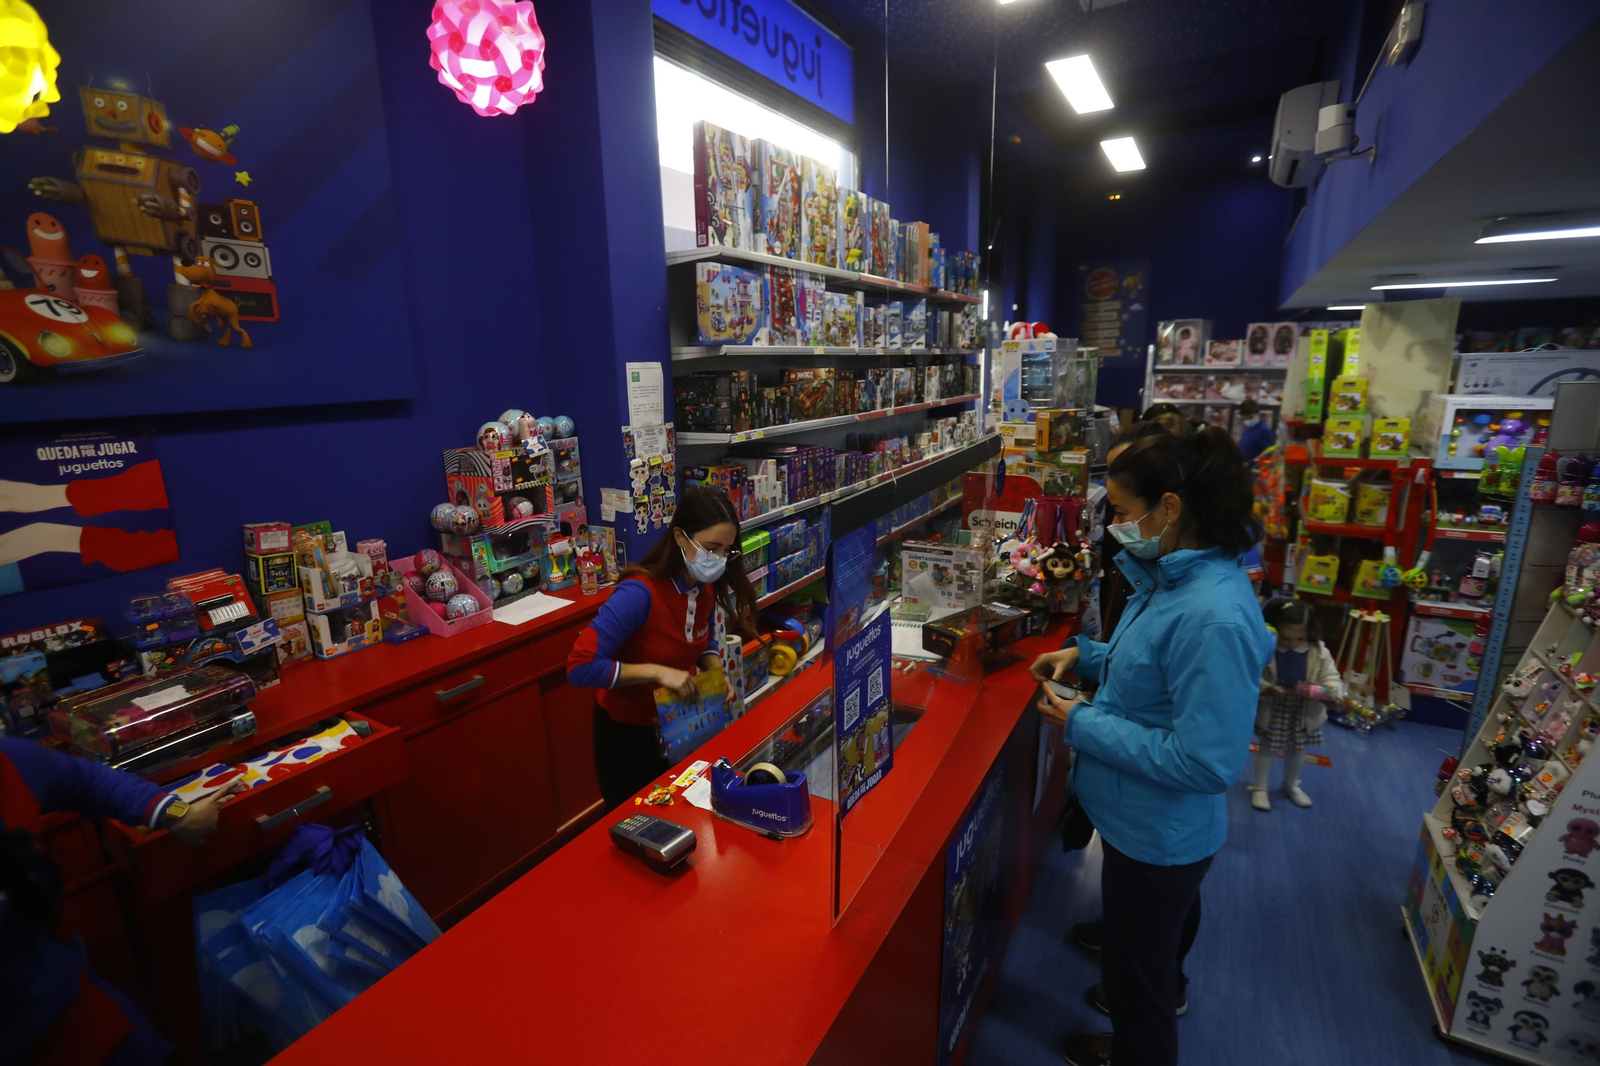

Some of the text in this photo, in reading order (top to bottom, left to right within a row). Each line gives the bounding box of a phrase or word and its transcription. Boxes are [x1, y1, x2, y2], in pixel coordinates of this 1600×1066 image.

[29, 299, 83, 317] 79
[37, 445, 79, 461] QUEDA
[81, 448, 97, 458] POR
[97, 441, 138, 456] JUGAR
[58, 458, 125, 476] juguettos
[972, 516, 1018, 530] Schleich
[908, 554, 953, 564] CUENTACUENTOS
[1, 620, 83, 649] ROBLOX
[845, 624, 882, 666] juguettos
[865, 768, 882, 790] JUGAR
[752, 808, 789, 824] juguettos
[956, 768, 1004, 874] juguettos
[1544, 901, 1581, 915] Coconut
